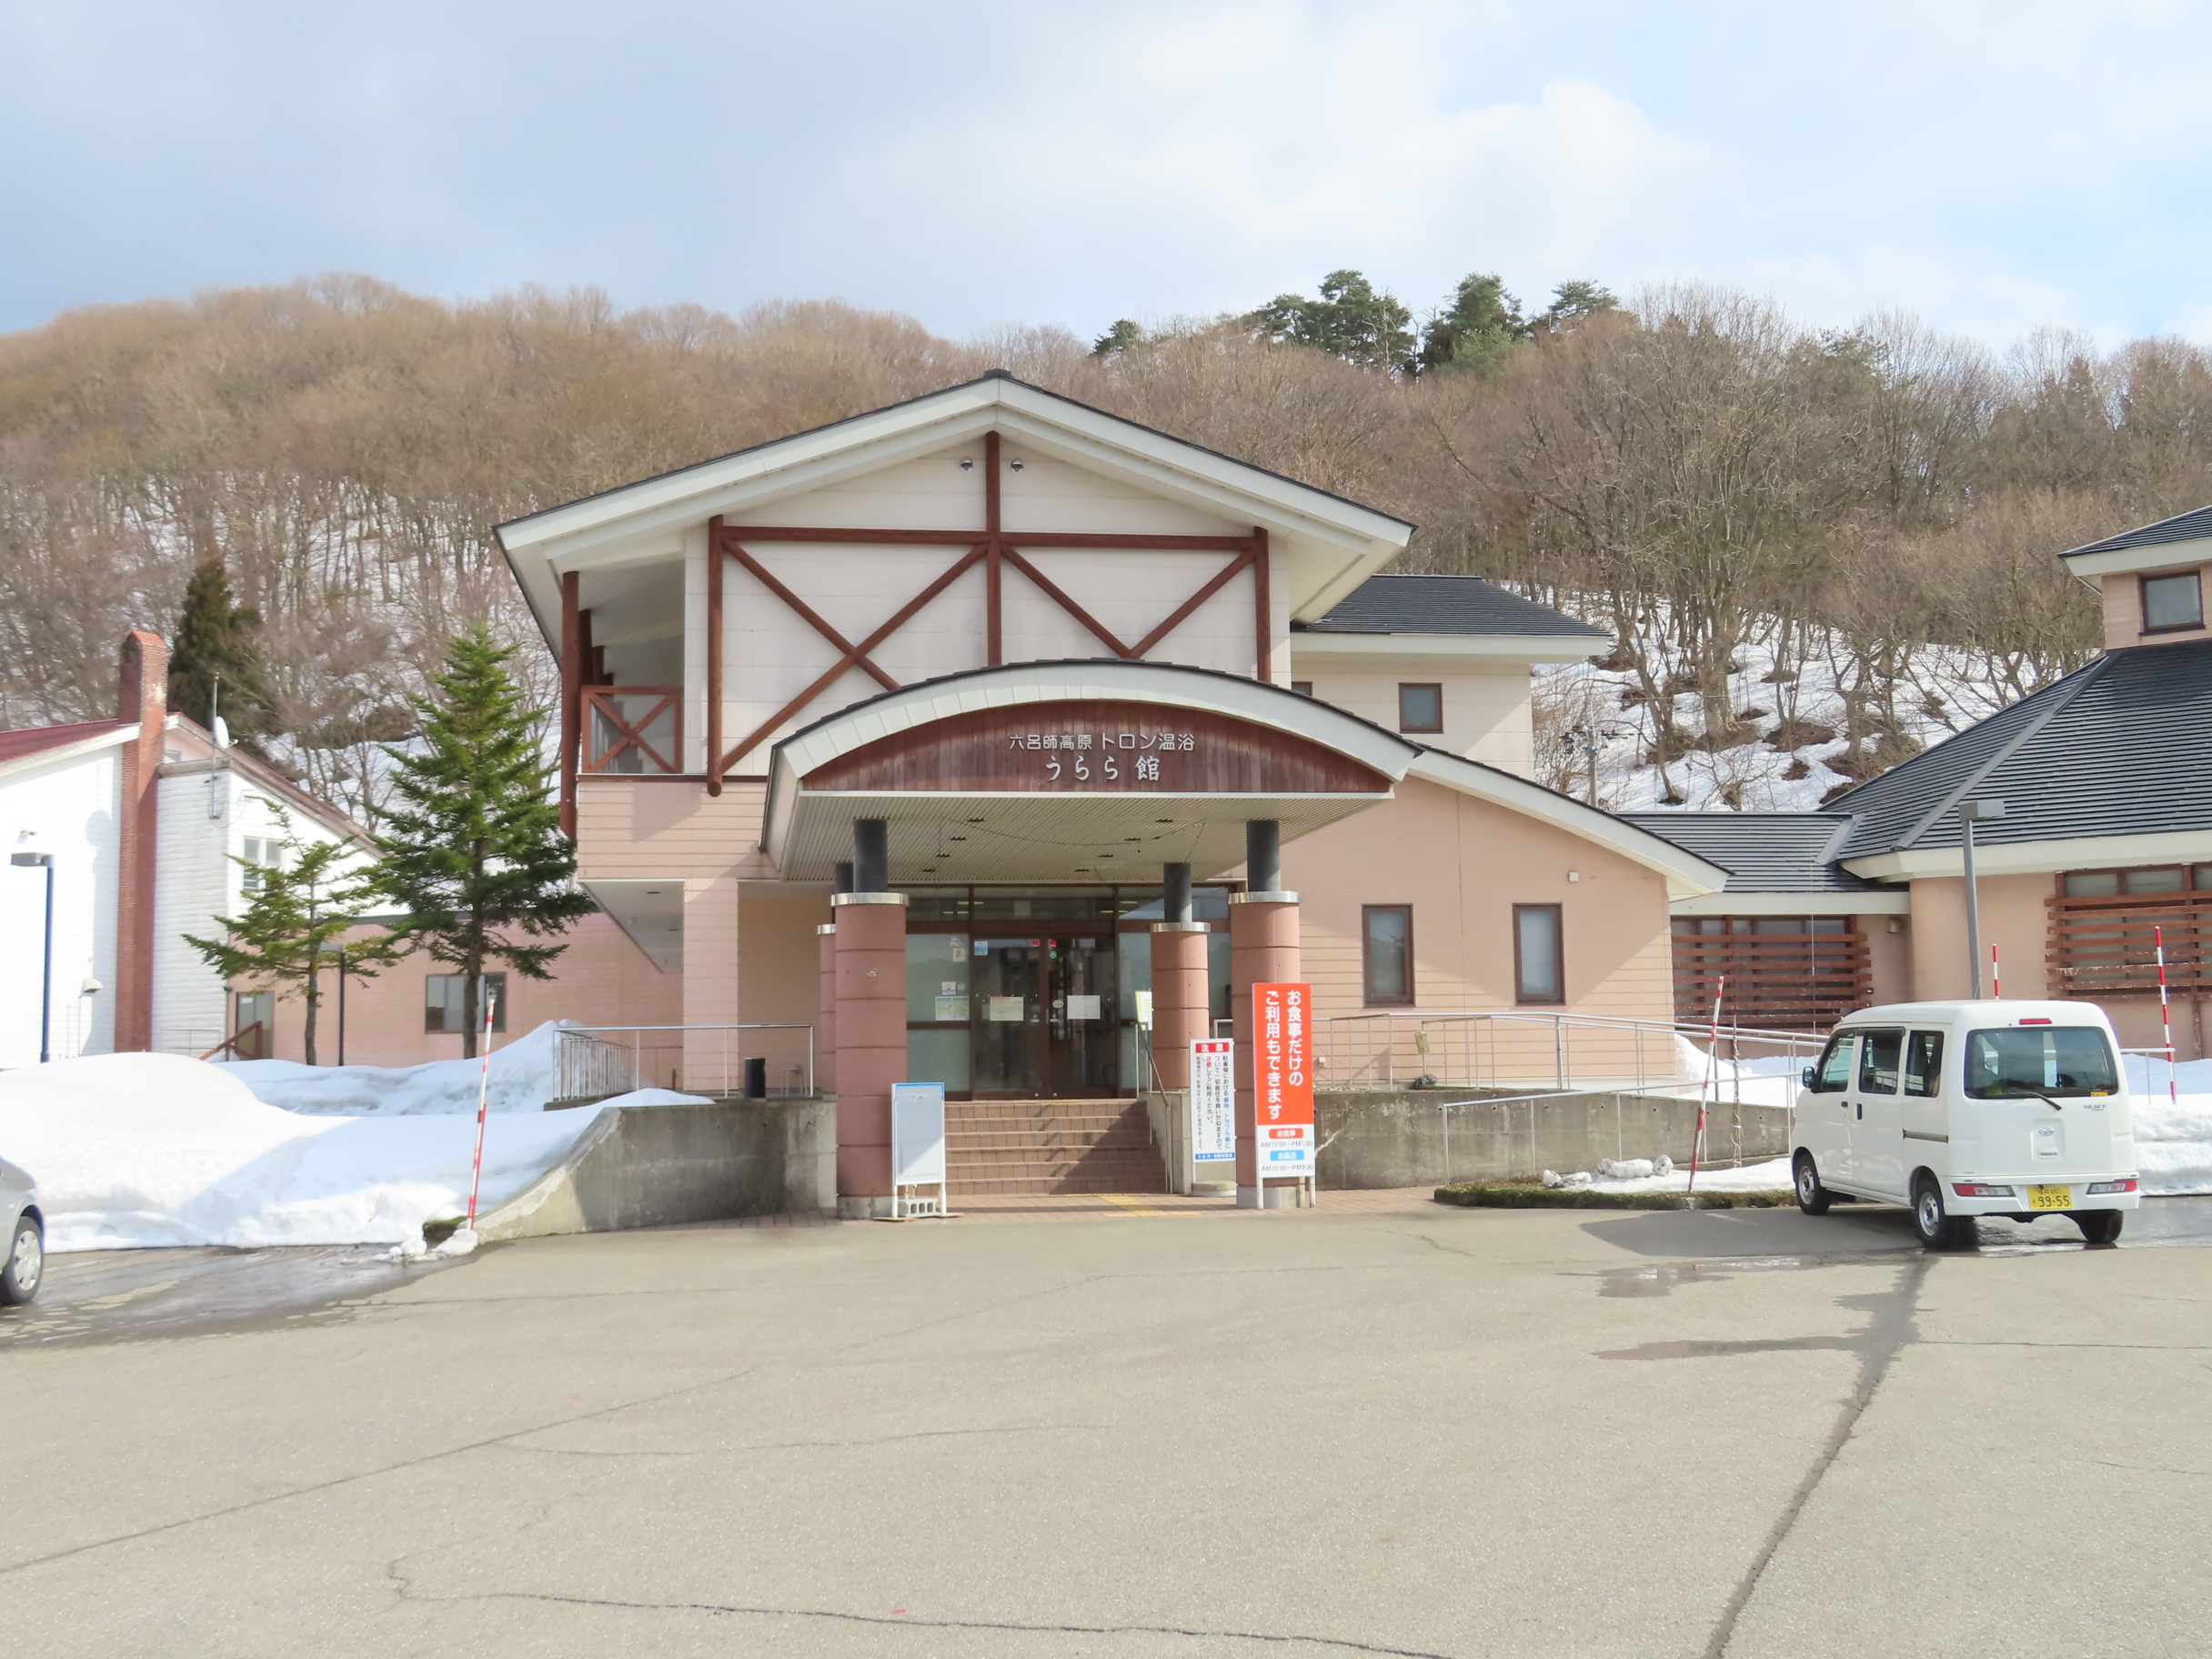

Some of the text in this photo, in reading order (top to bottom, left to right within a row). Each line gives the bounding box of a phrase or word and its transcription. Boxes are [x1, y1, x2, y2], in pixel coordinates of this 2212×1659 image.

[1009, 732, 1195, 751] 六呂師高原 トロン温浴
[1045, 755, 1161, 781] うらら館
[1287, 990, 1303, 1087] お食事だけの
[1201, 1043, 1224, 1052] 注意
[1265, 990, 1282, 1120] ご利用もできます
[1276, 1130, 1296, 1138] お食事
[1278, 1151, 1297, 1160] お風呂
[2037, 1195, 2070, 1208] 99-55
